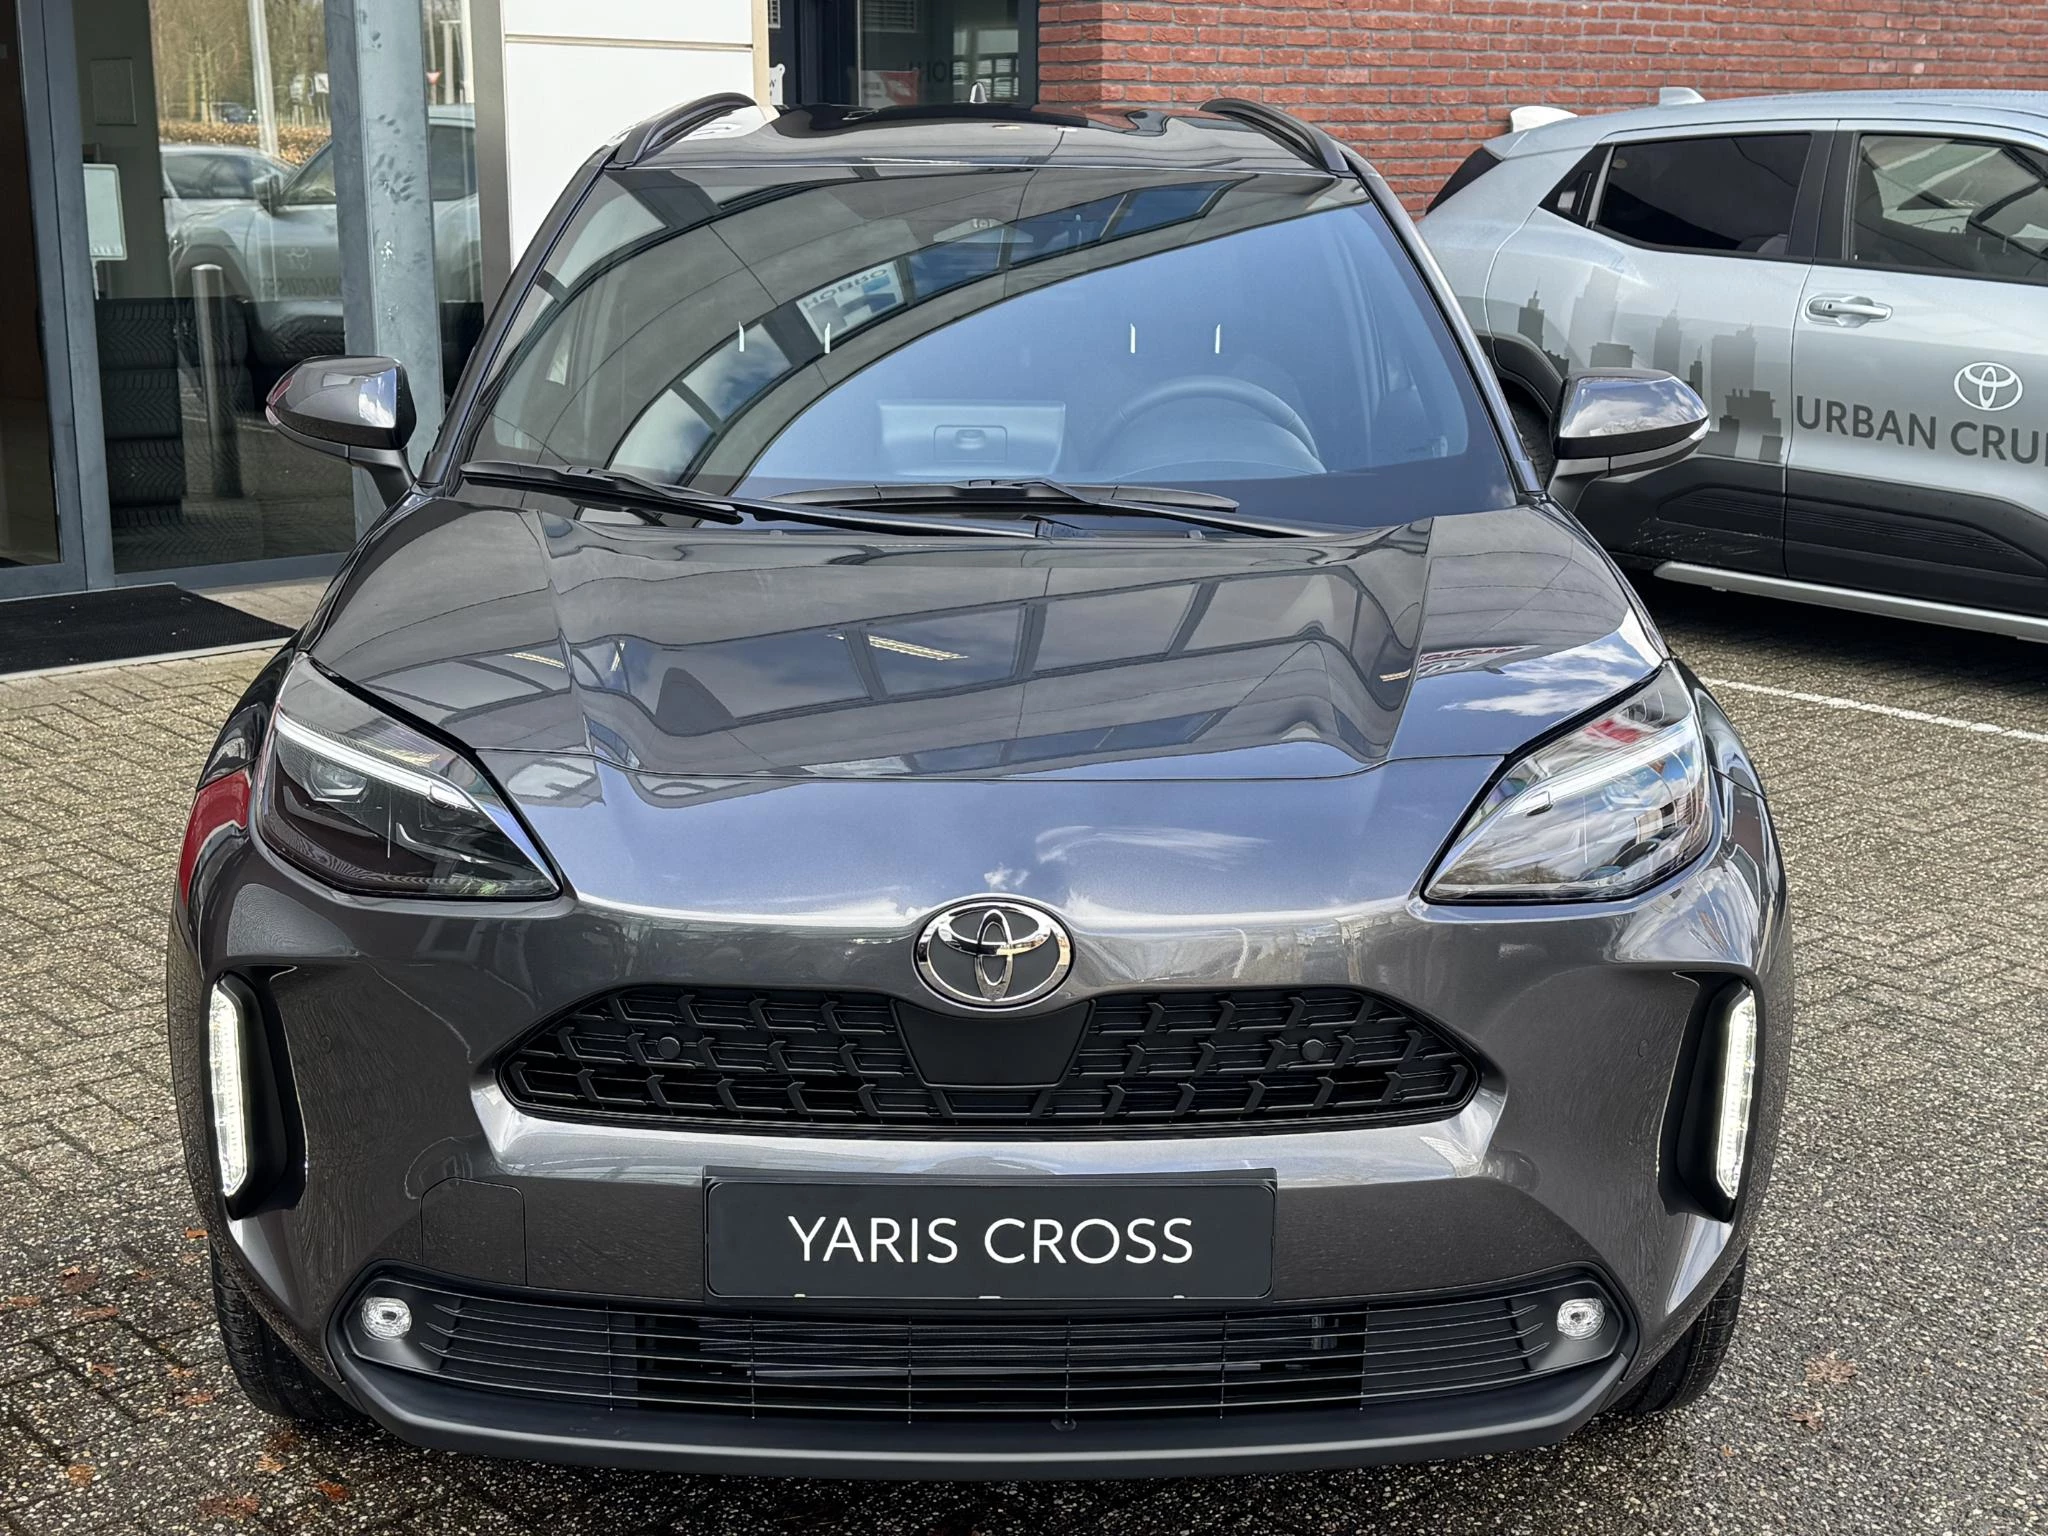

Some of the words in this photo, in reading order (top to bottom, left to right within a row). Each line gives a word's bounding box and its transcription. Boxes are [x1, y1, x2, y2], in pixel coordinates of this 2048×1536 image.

[1796, 395, 1937, 450] URBAN
[788, 1216, 958, 1264] YARIS
[984, 1217, 1193, 1264] CROSS
